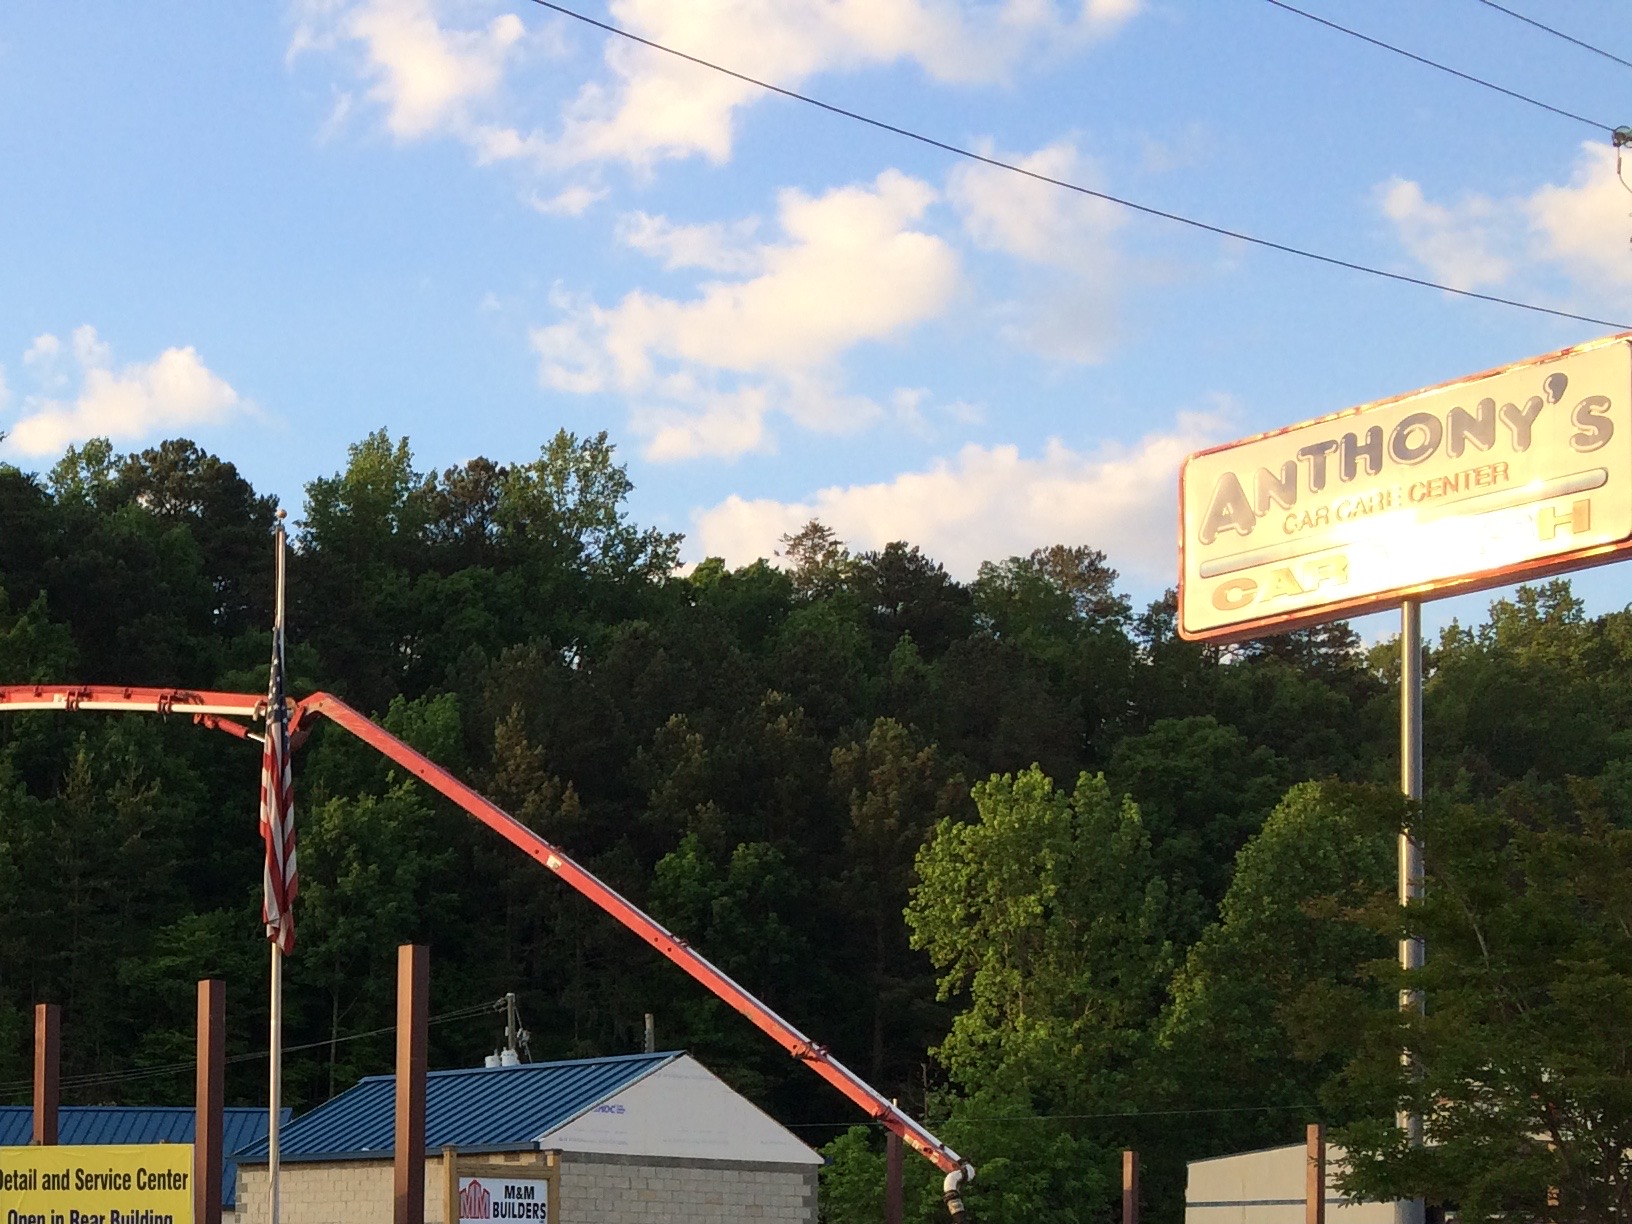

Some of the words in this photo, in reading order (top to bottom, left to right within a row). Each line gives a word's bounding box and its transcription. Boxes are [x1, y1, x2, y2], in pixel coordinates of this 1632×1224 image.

[1198, 373, 1614, 545] ANTHONY'S
[1282, 505, 1331, 534] CAR
[1408, 461, 1509, 503] CENTER
[42, 1168, 70, 1191] and
[75, 1168, 131, 1191] Service
[136, 1167, 189, 1191] Center
[504, 1185, 535, 1200] M&M
[492, 1202, 546, 1219] BUILDERS
